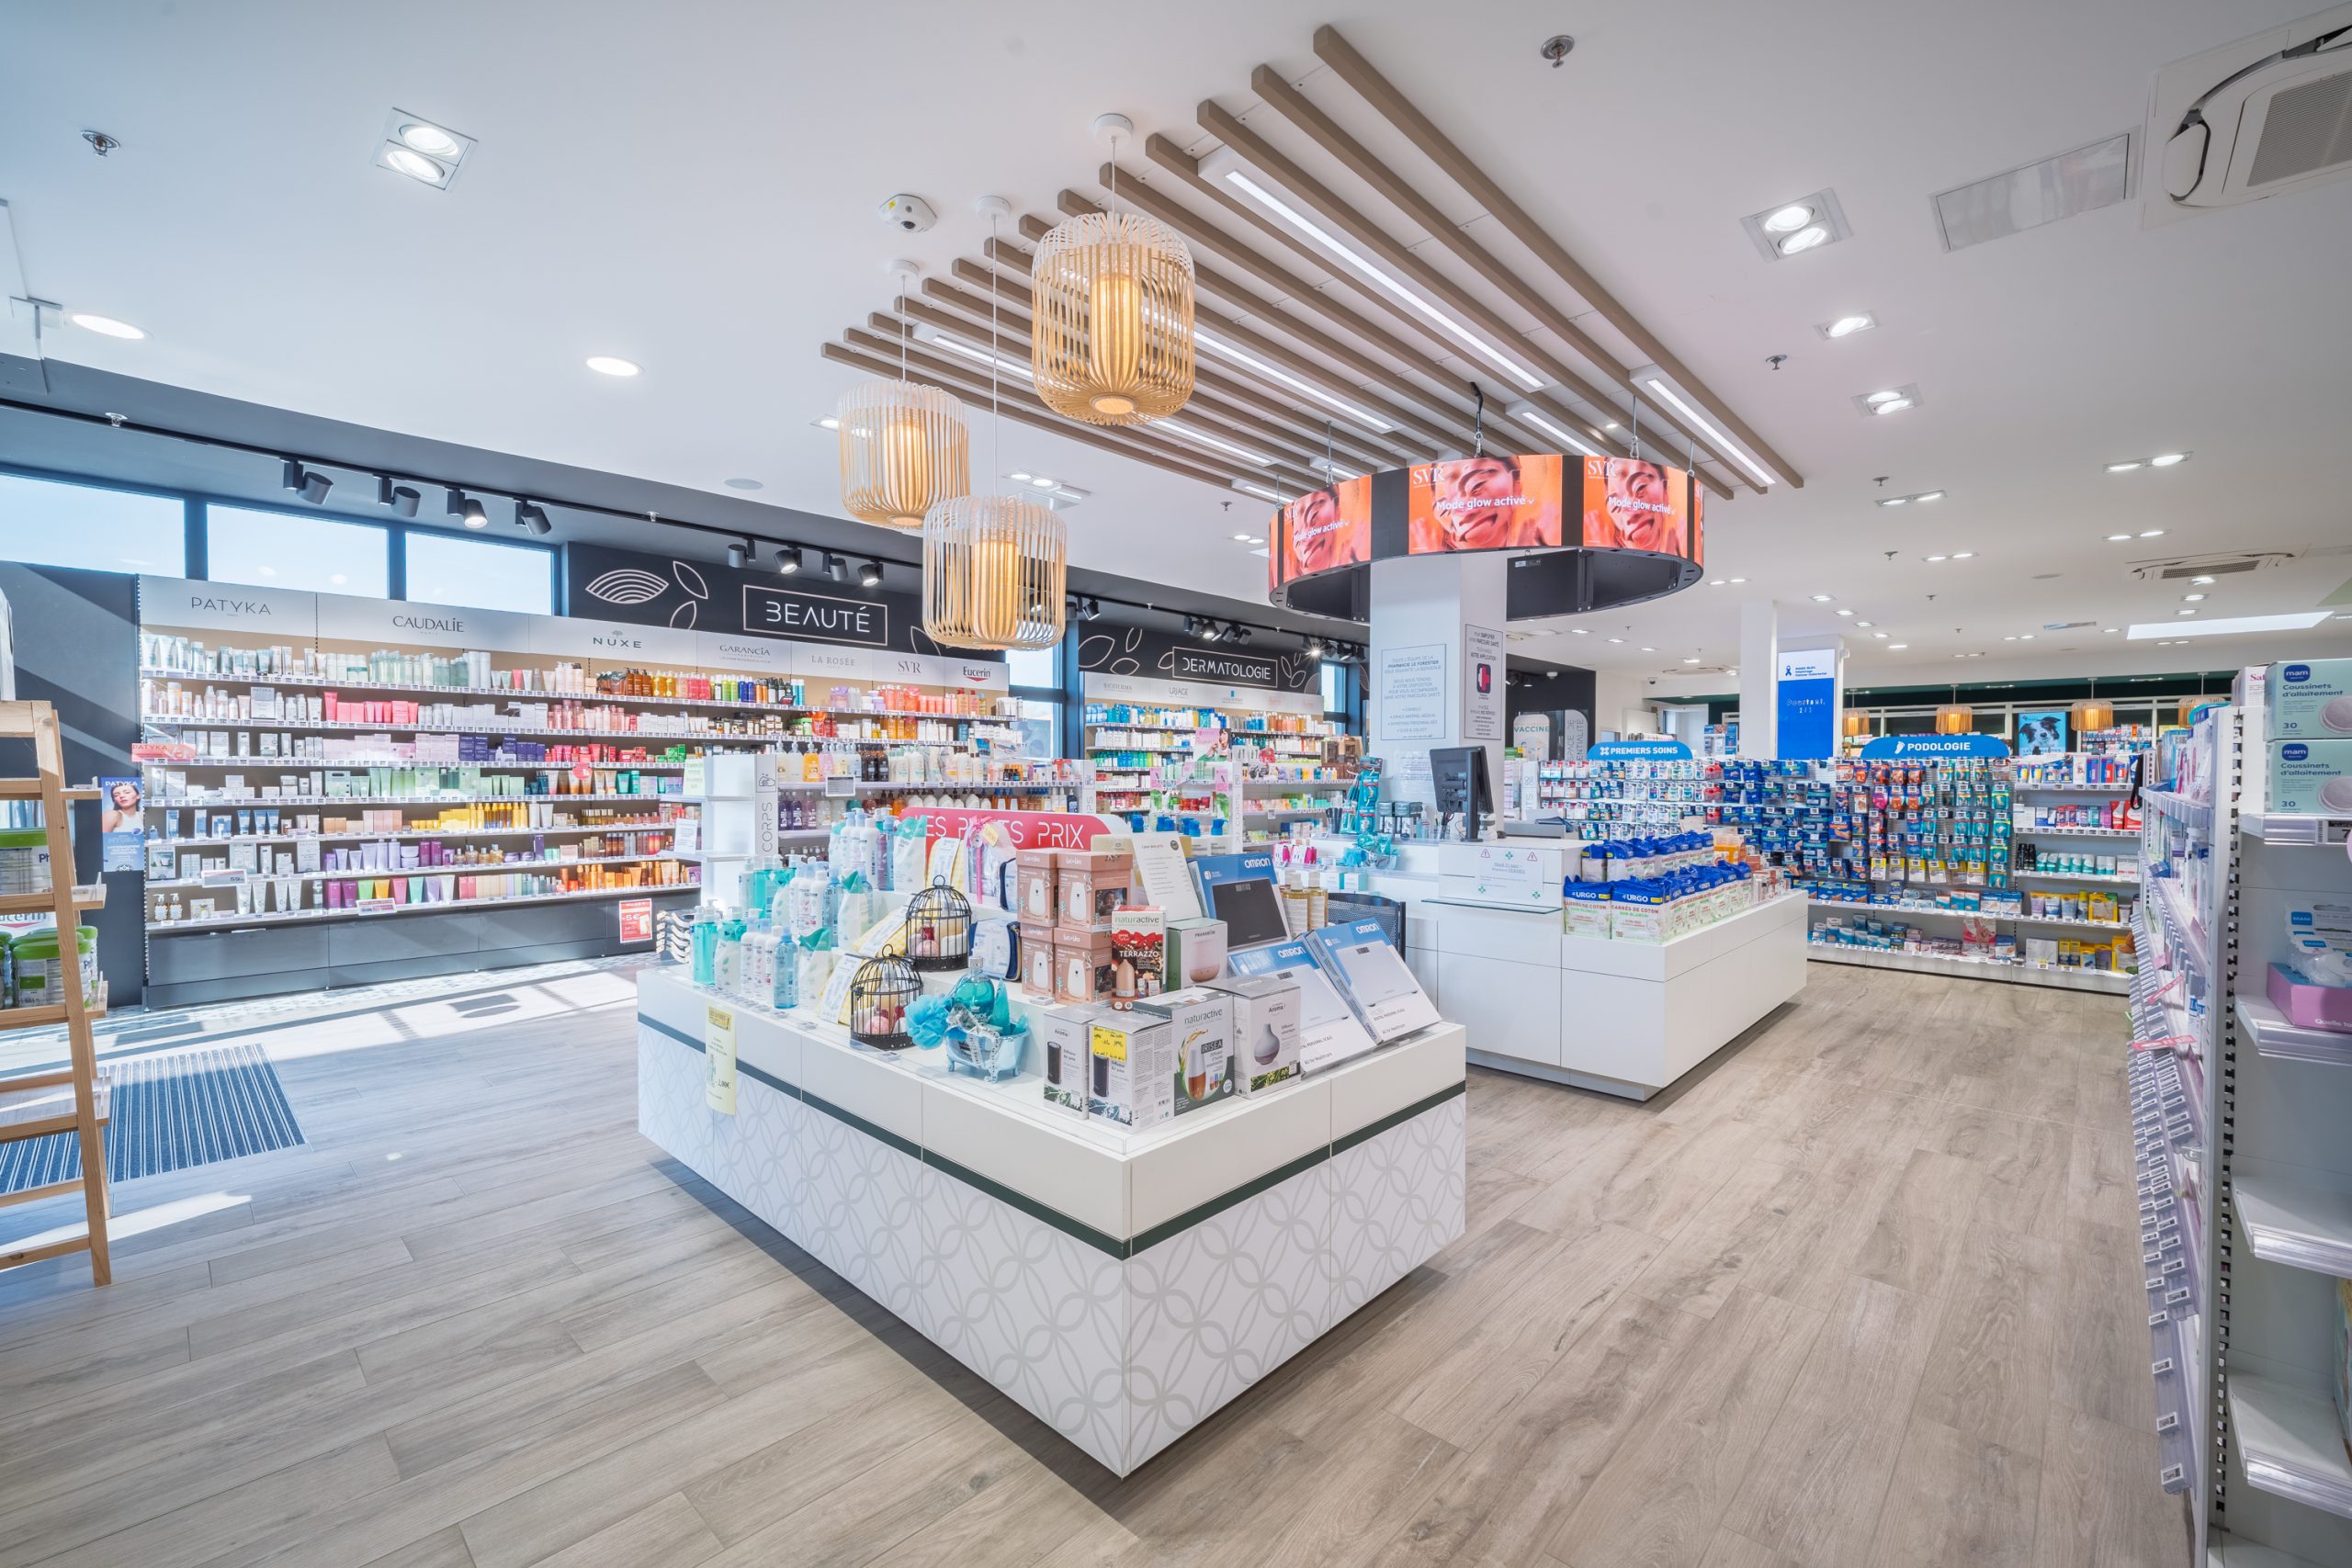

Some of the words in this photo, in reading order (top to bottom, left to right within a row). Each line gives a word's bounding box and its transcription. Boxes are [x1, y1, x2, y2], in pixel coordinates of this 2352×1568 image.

[1588, 460, 1616, 477] SVR
[1413, 468, 1444, 485] SVR
[1437, 500, 1464, 511] Mode
[1467, 498, 1492, 511] glow
[1494, 495, 1526, 505] activé
[1609, 496, 1632, 508] Mode
[1634, 500, 1650, 511] glow
[1307, 526, 1321, 539] glow
[191, 597, 272, 615] PATYKA
[765, 601, 870, 633] BEAUTÉ
[593, 637, 641, 649] NUXE
[827, 656, 855, 666] ROSÉE
[898, 660, 922, 674] SVR
[963, 666, 991, 678] Eucerin
[1182, 658, 1271, 680] DERMATOLOGIE
[1169, 687, 1189, 695] URIAGE
[1566, 736, 1575, 761] SPACE
[1907, 741, 1971, 751] PODOLOGIE
[762, 801, 773, 852] CORPS
[915, 816, 947, 837] ES
[958, 817, 1023, 843] PTS
[1038, 821, 1084, 849] PRIX
[1244, 858, 1271, 868] OMRON
[1356, 922, 1379, 934] OMRON
[1277, 946, 1306, 958] OMRON
[1184, 1009, 1222, 1025] naturactive
[2315, 1019, 2342, 1027] Quelle
[1202, 1040, 1222, 1053] IRISEA
